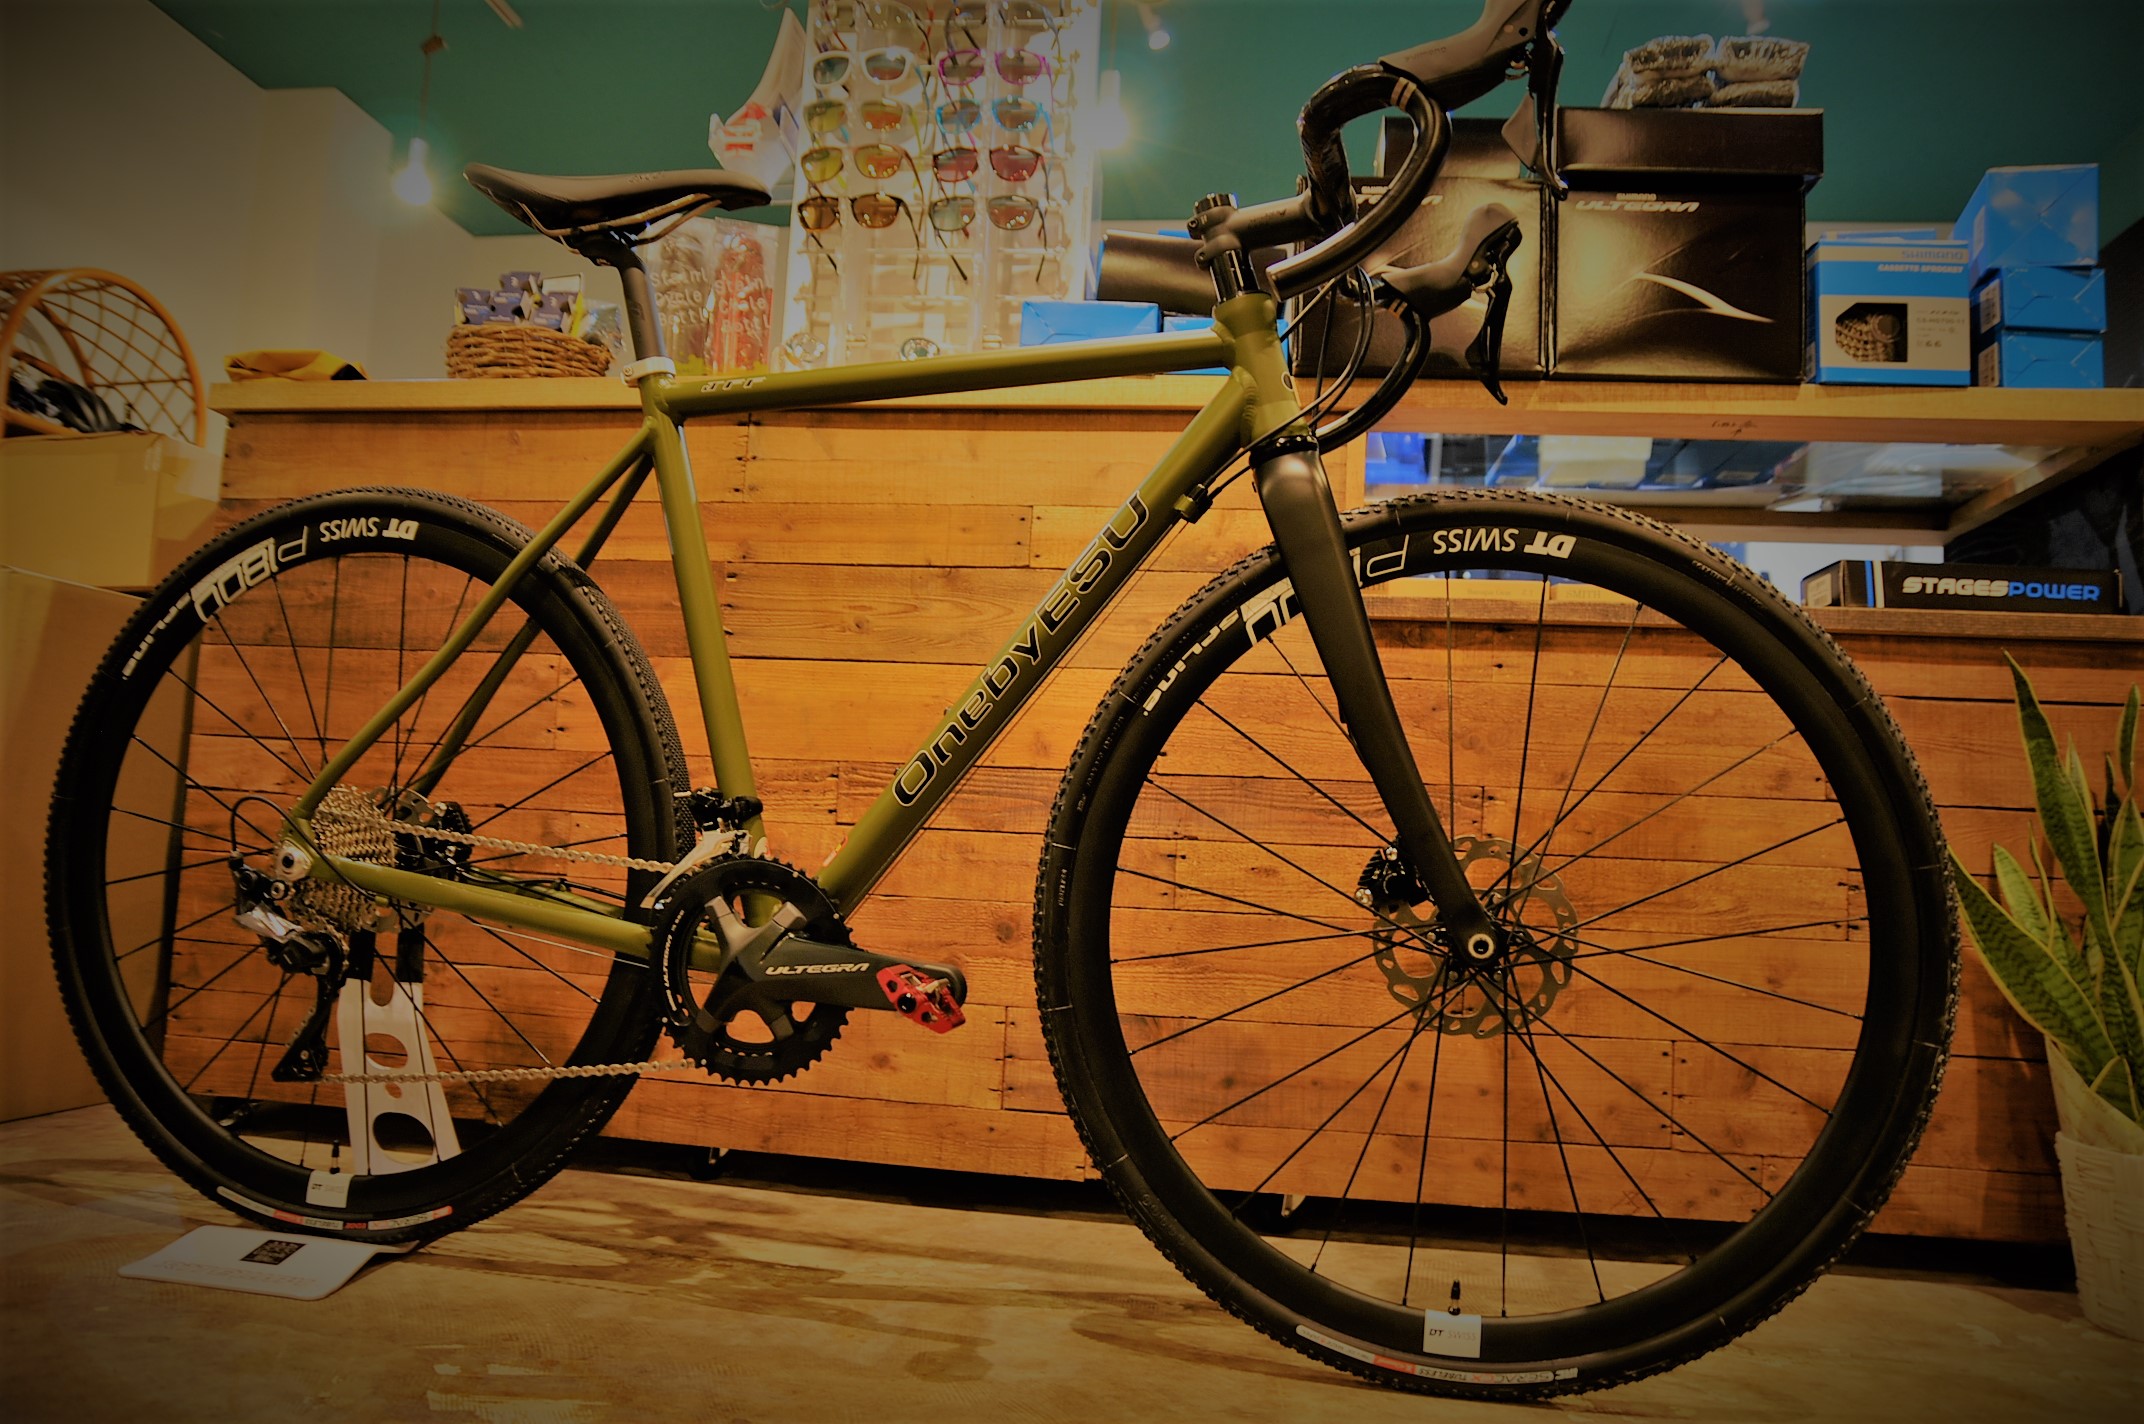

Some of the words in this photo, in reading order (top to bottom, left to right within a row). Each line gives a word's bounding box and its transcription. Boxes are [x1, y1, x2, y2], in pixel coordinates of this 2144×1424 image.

[1575, 200, 1700, 213] ULTEGRA
[1901, 249, 1964, 260] SHIMANO
[319, 517, 380, 544] SWISS
[383, 518, 420, 541] DT
[1432, 527, 1519, 555] SWISS
[1524, 530, 1577, 560] DT
[765, 961, 870, 977] ULTEGRA
[1429, 1329, 1445, 1337] DT
[1419, 1367, 1468, 1381] TUBELESS
